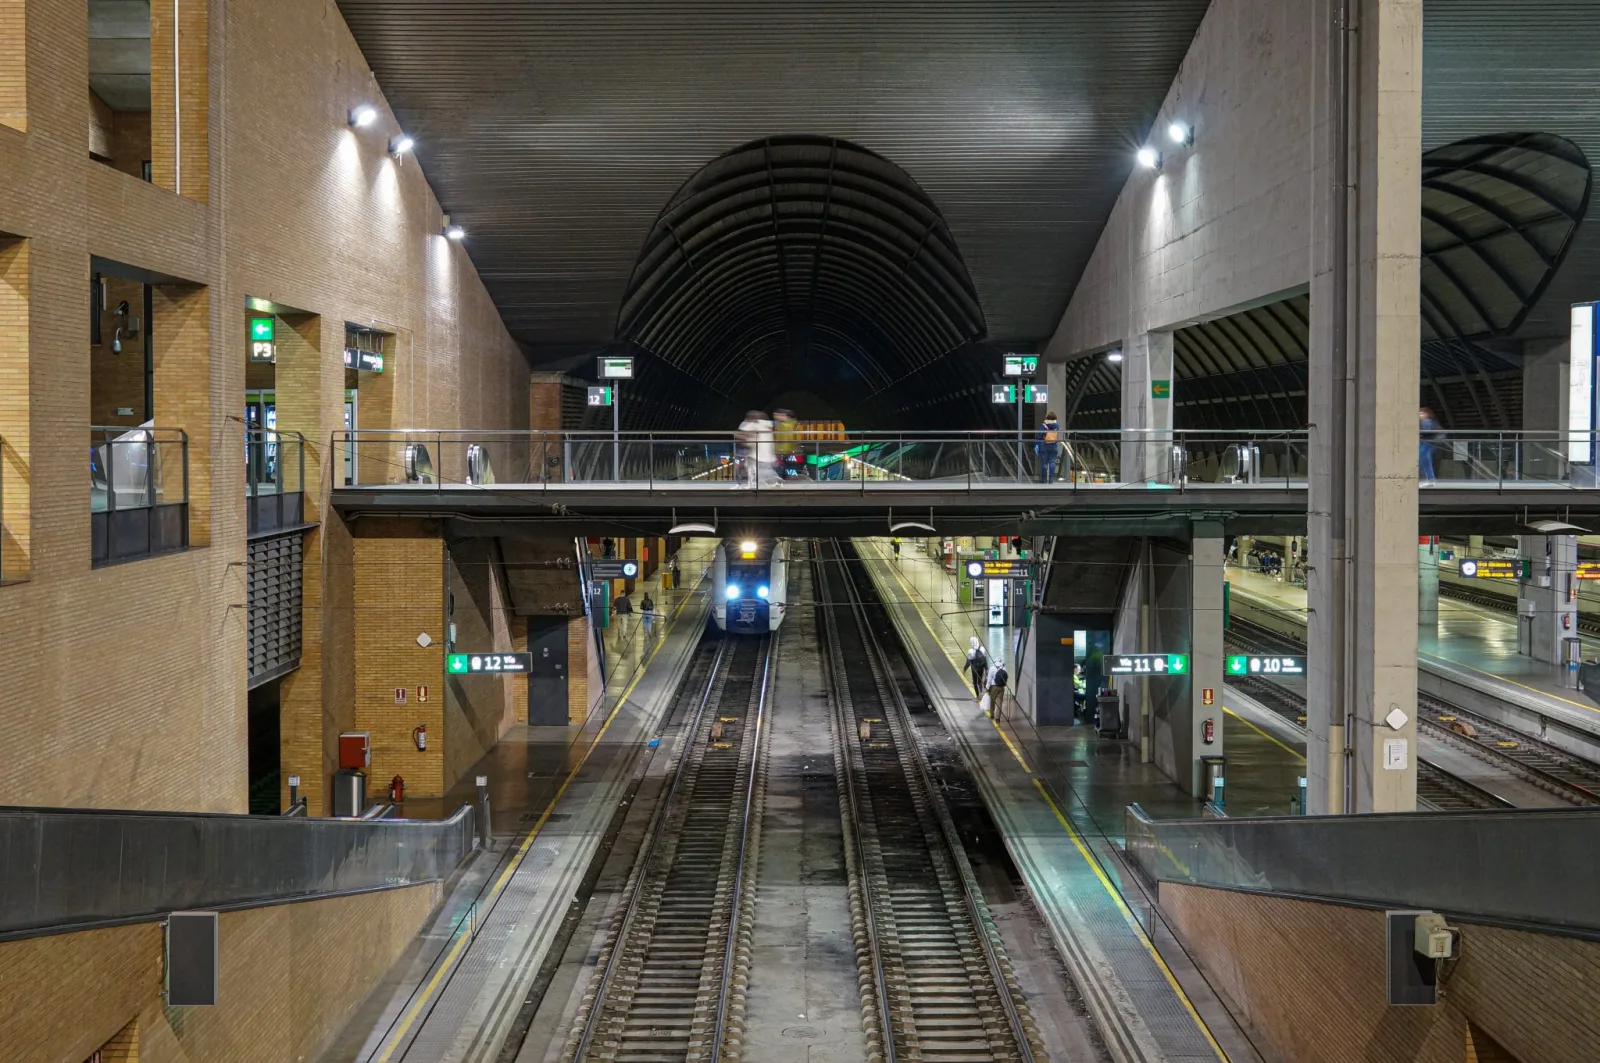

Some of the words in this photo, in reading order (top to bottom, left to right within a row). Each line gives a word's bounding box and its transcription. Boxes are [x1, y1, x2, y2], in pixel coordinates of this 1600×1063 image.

[253, 342, 272, 357] P3
[1022, 361, 1036, 372] 10
[588, 394, 600, 405] 12
[994, 392, 1006, 402] 11
[1035, 392, 1047, 402] 10
[1019, 569, 1028, 577] 11
[484, 656, 501, 670] 12
[1134, 658, 1151, 672] 11
[1263, 658, 1280, 672] 10
